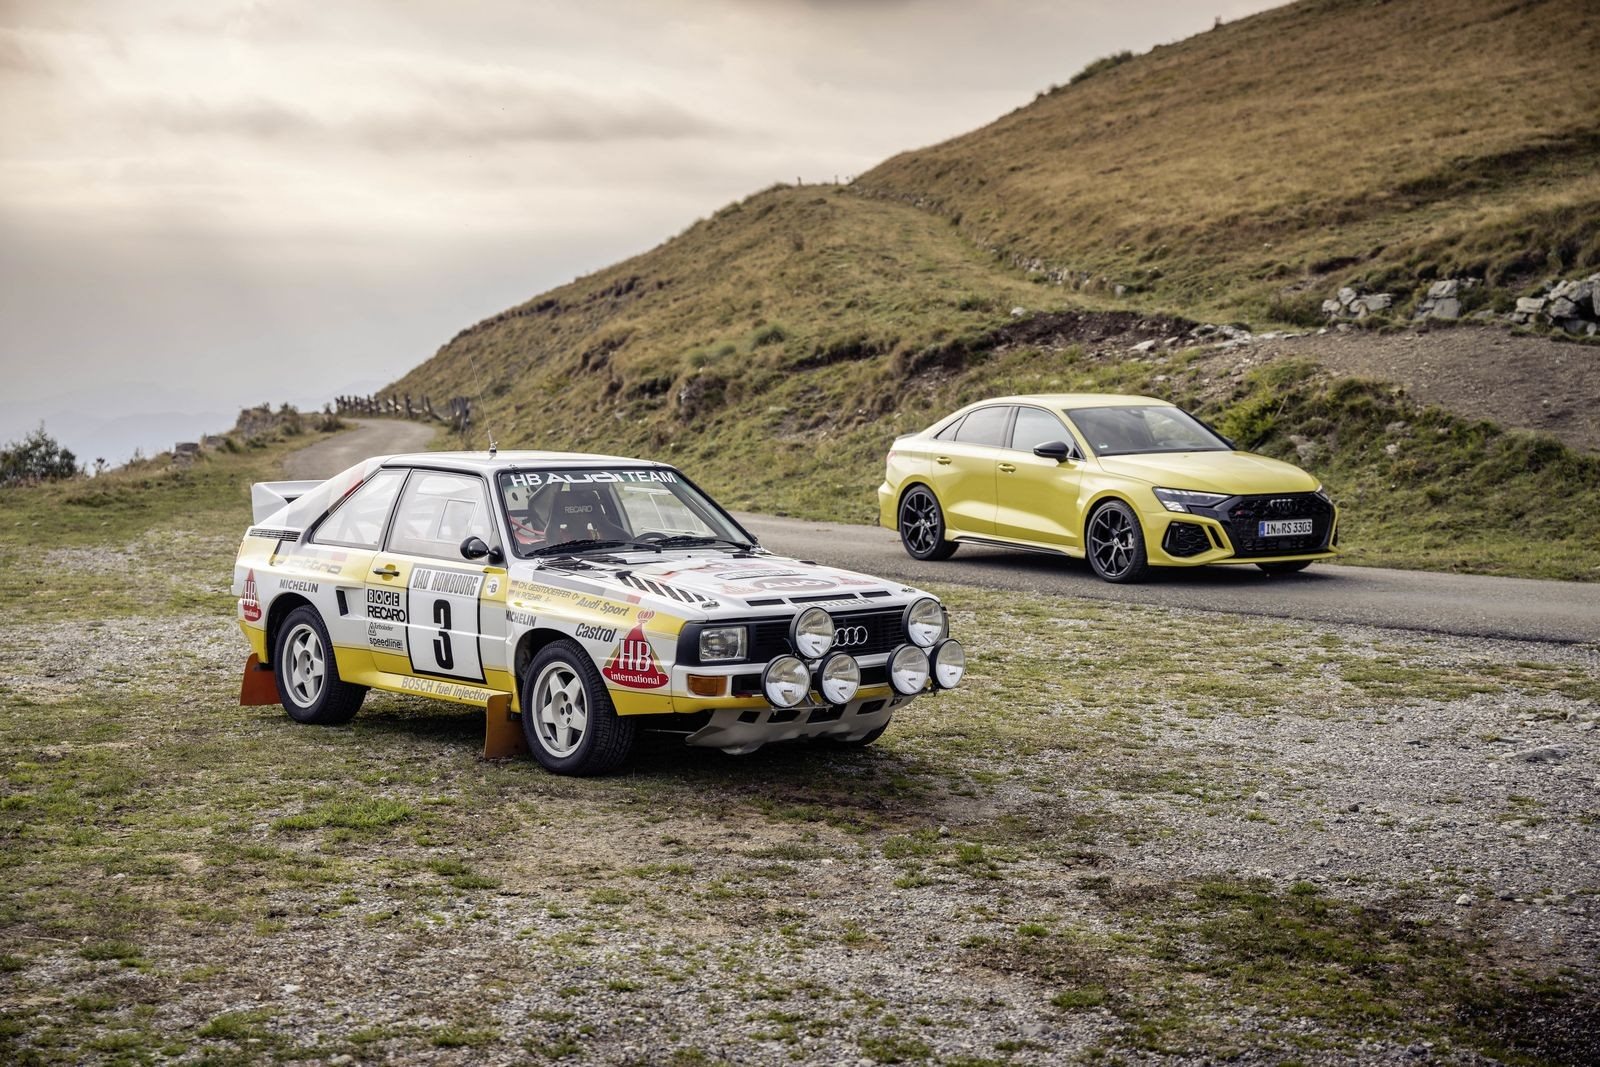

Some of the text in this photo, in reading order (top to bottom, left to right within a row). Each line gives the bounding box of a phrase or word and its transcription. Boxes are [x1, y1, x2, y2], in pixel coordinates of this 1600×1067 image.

[509, 473, 542, 488] HB
[622, 471, 678, 484] TEAM
[564, 505, 593, 514] RECARO
[1266, 521, 1312, 535] IN RS 3303
[279, 579, 319, 593] MICHELIN
[412, 569, 479, 597] BAD HOMBOURG
[367, 589, 400, 606] BOGE
[367, 605, 406, 622] RECARO
[575, 596, 630, 617] Audi Sport
[505, 609, 537, 627] MICHELIN
[432, 598, 454, 670] 3
[575, 622, 618, 643] Castrol
[368, 637, 402, 649] speedline
[618, 638, 653, 672] HB
[610, 671, 660, 685] international
[401, 677, 491, 702] BOSCH fuel injection
